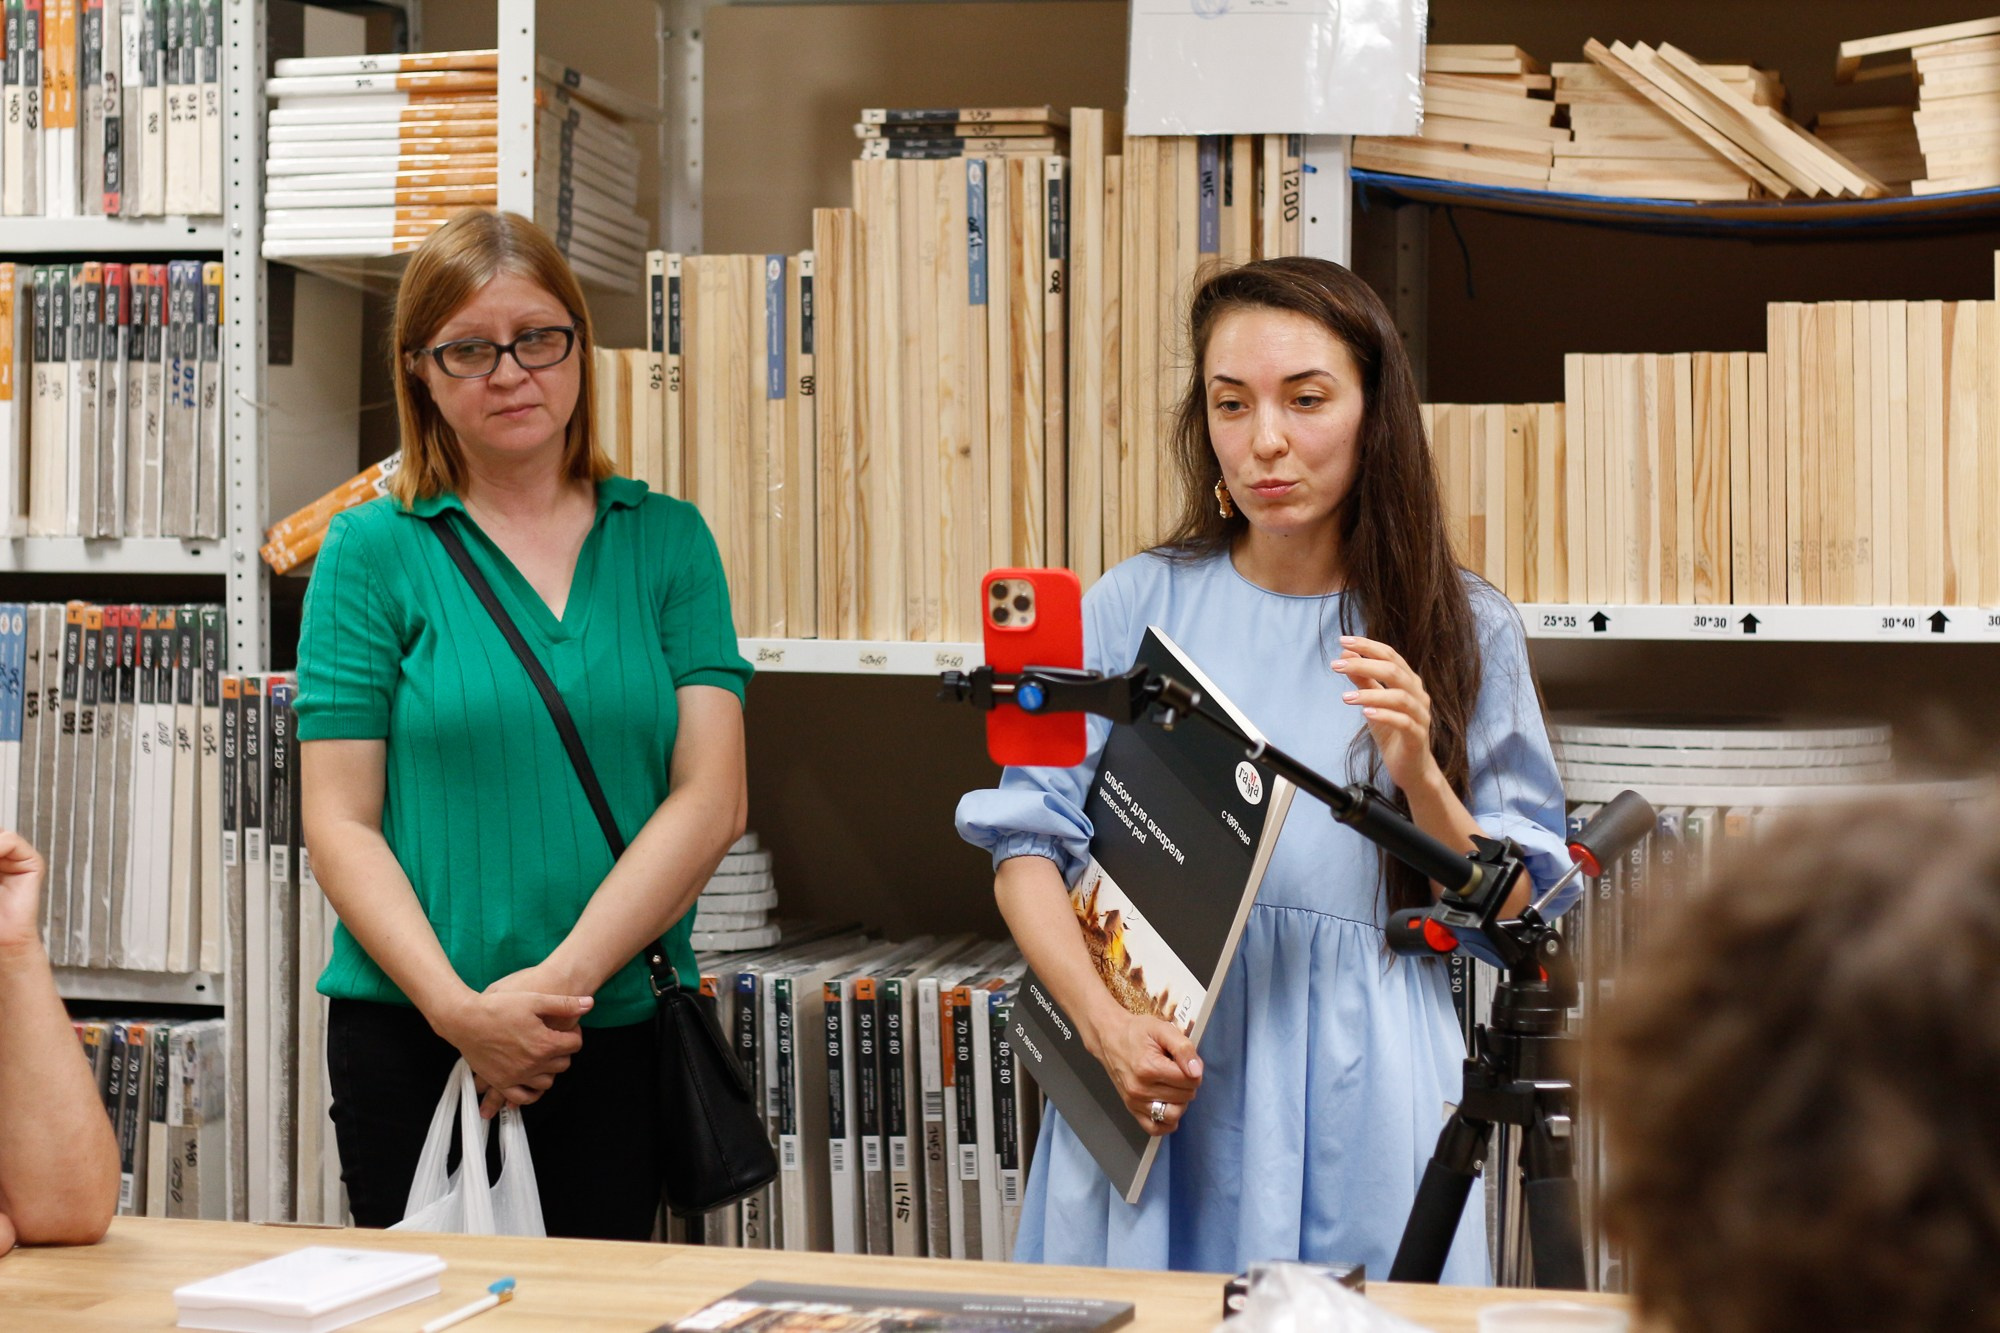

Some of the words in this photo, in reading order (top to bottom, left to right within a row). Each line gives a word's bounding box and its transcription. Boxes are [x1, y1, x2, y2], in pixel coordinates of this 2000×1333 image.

[1282, 170, 1300, 222] 1200
[650, 364, 662, 390] 570
[668, 367, 680, 392] 570
[184, 366, 196, 409] 750
[70, 610, 79, 619] T
[88, 615, 97, 624] T
[182, 612, 192, 623] T
[204, 614, 215, 626] T
[227, 682, 236, 692] T
[276, 688, 286, 701] T
[274, 714, 284, 736] 100
[224, 737, 234, 758] 120
[246, 734, 256, 755] 120
[274, 747, 284, 768] 120
[1100, 786, 1134, 829] watercolour
[1132, 826, 1148, 844] pad
[1104, 770, 1132, 806] альбом
[1130, 802, 1148, 824] для
[1147, 818, 1185, 866] акварели
[1226, 814, 1240, 830] 1899
[1237, 828, 1251, 846] года
[1570, 818, 1582, 832] T
[1688, 820, 1700, 833] T
[1631, 849, 1642, 864] 60
[1662, 850, 1672, 864] 50
[1600, 878, 1611, 899] 100
[1452, 952, 1462, 965] 0
[742, 976, 752, 989] T
[778, 982, 789, 994] T
[861, 984, 870, 992] T
[888, 984, 898, 995] T
[1452, 977, 1462, 992] 90
[956, 989, 966, 1000] T
[742, 1007, 752, 1022] 40
[998, 1009, 1010, 1022] T
[1030, 984, 1052, 1014] старый
[1050, 1010, 1072, 1040] мастер
[780, 1012, 790, 1027] 40
[828, 1016, 839, 1030] 50
[860, 1014, 872, 1028] 50
[888, 1014, 900, 1028] 50
[133, 1030, 141, 1038] T
[958, 1020, 968, 1034] 70
[742, 1033, 752, 1048] 80
[780, 1038, 790, 1054] 80
[860, 1040, 872, 1054] 80
[888, 1040, 900, 1054] 80
[1016, 1023, 1024, 1037] 20
[1022, 1035, 1043, 1062] листов
[828, 1041, 839, 1056] 80
[958, 1046, 968, 1060] 80
[999, 1042, 1011, 1056] 80
[112, 1056, 121, 1070] 60
[130, 1058, 139, 1072] 70
[999, 1068, 1011, 1084] 80
[109, 1081, 118, 1095] 70
[128, 1082, 136, 1096] 70
[894, 1182, 911, 1223] 1145
